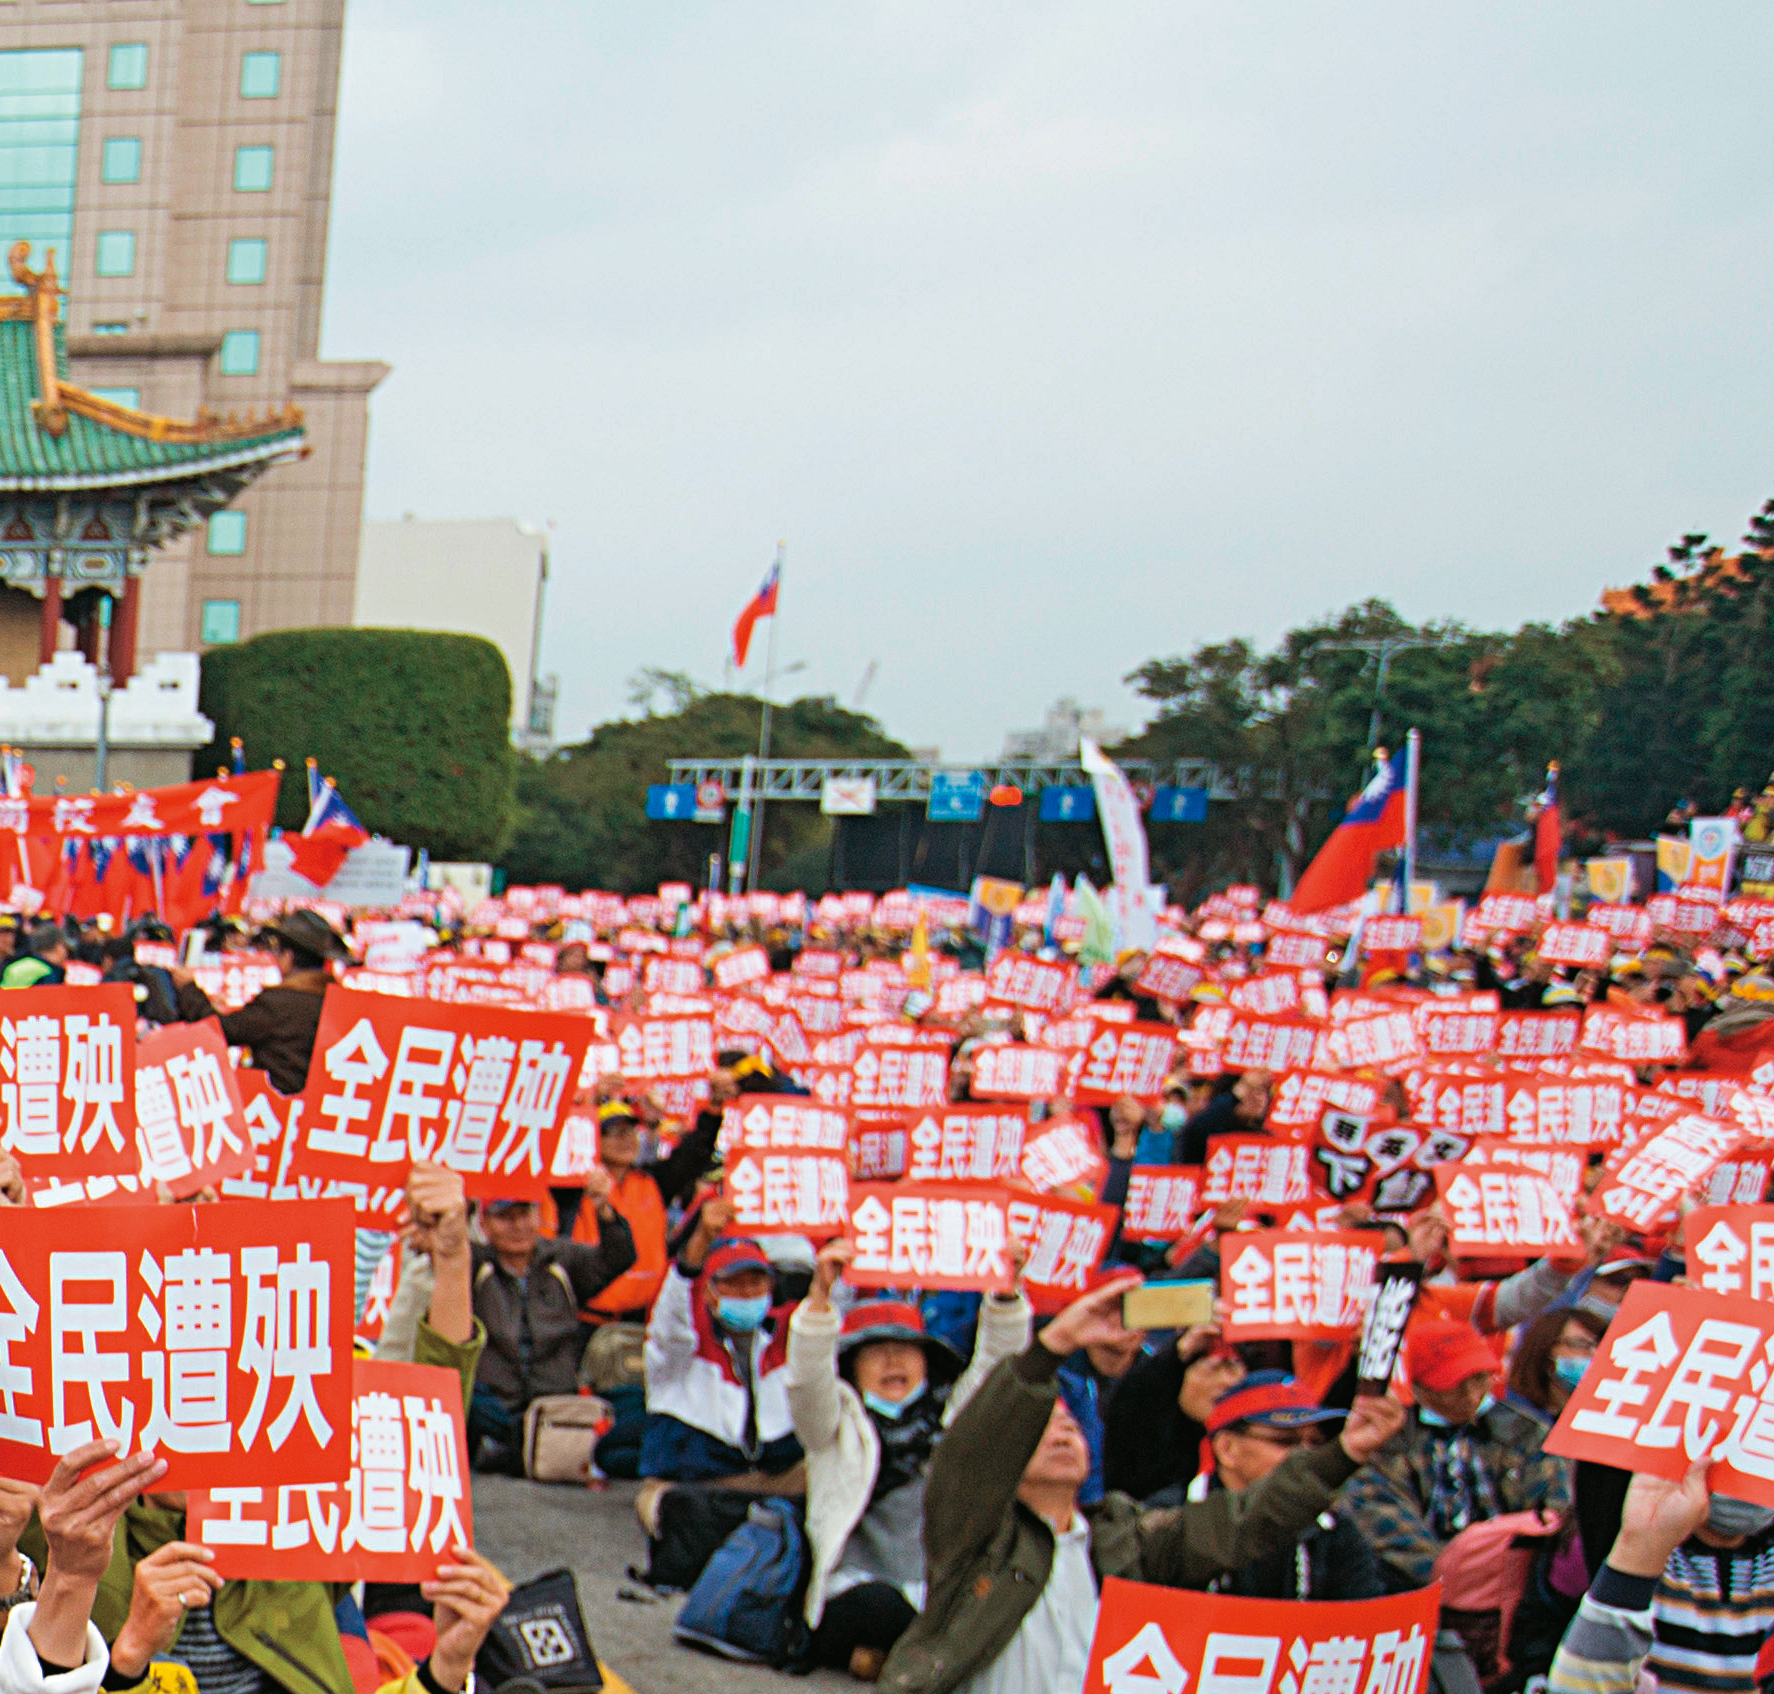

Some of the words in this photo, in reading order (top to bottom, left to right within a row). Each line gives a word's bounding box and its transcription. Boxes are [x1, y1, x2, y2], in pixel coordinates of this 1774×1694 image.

[618, 1019, 714, 1076] 全民遭殃
[1080, 1032, 1174, 1096] 全民遭殃
[306, 1017, 572, 1177] 全民遭殃
[1437, 1082, 1506, 1132] 全民遭
[1507, 1087, 1624, 1144] 全民遭殃
[910, 1114, 1025, 1179] 全民遭殃
[1203, 1143, 1310, 1204] 全民遭殃
[729, 1156, 848, 1227] 全民遭殃
[1446, 1181, 1579, 1250] 全民遭殃
[852, 1198, 1005, 1278] 全民遭殃
[1229, 1244, 1380, 1326] 全民遭殃
